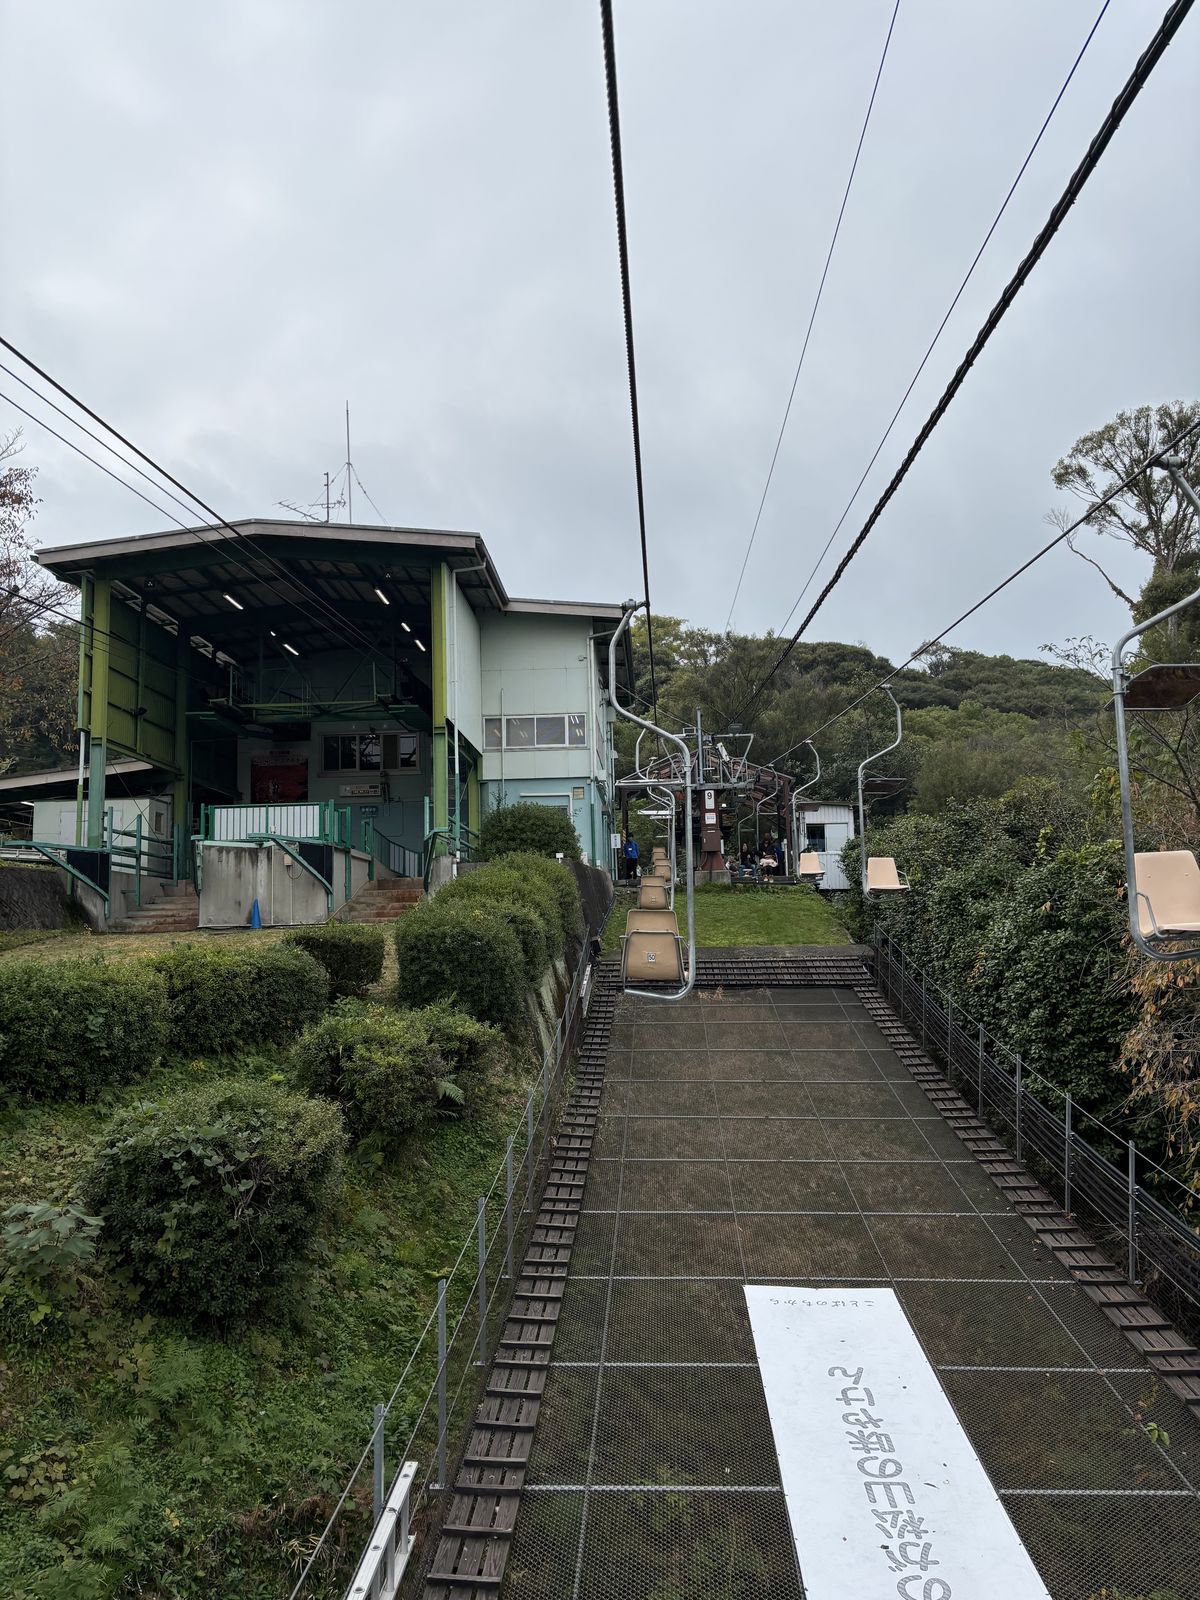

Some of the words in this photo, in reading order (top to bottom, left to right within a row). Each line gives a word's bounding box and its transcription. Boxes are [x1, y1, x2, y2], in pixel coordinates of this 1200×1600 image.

[706, 791, 713, 800] 9
[769, 1297, 875, 1308] ことばのちから
